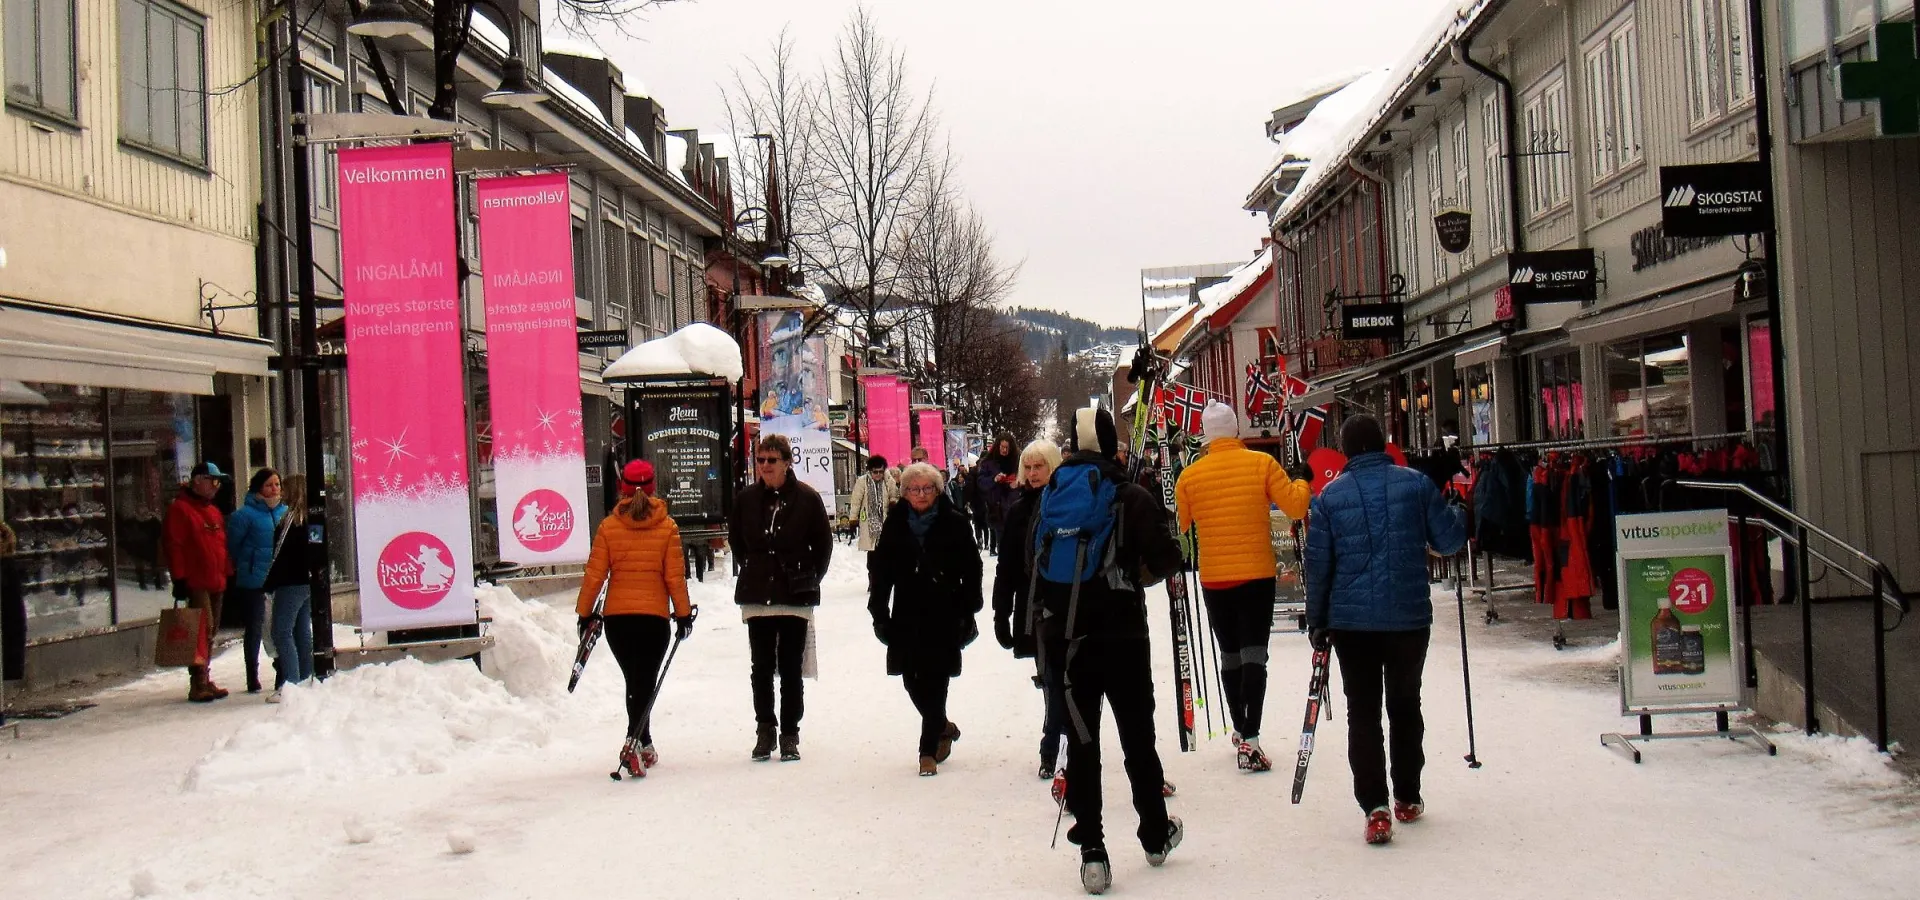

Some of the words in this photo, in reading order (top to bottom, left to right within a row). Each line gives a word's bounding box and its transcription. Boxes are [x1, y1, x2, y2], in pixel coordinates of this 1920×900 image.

[344, 167, 446, 184] Velkommen
[1698, 206, 1722, 214] Tailored
[1731, 205, 1753, 213] nature
[355, 258, 444, 282] INGALÅMI
[350, 301, 401, 318] Norges
[404, 297, 455, 313] største
[1352, 315, 1395, 328] BIKBOK
[352, 319, 454, 341] jentelangrenn
[579, 334, 625, 344] SKORINGEN
[647, 427, 688, 441] OPENING
[689, 427, 720, 441] HOURS
